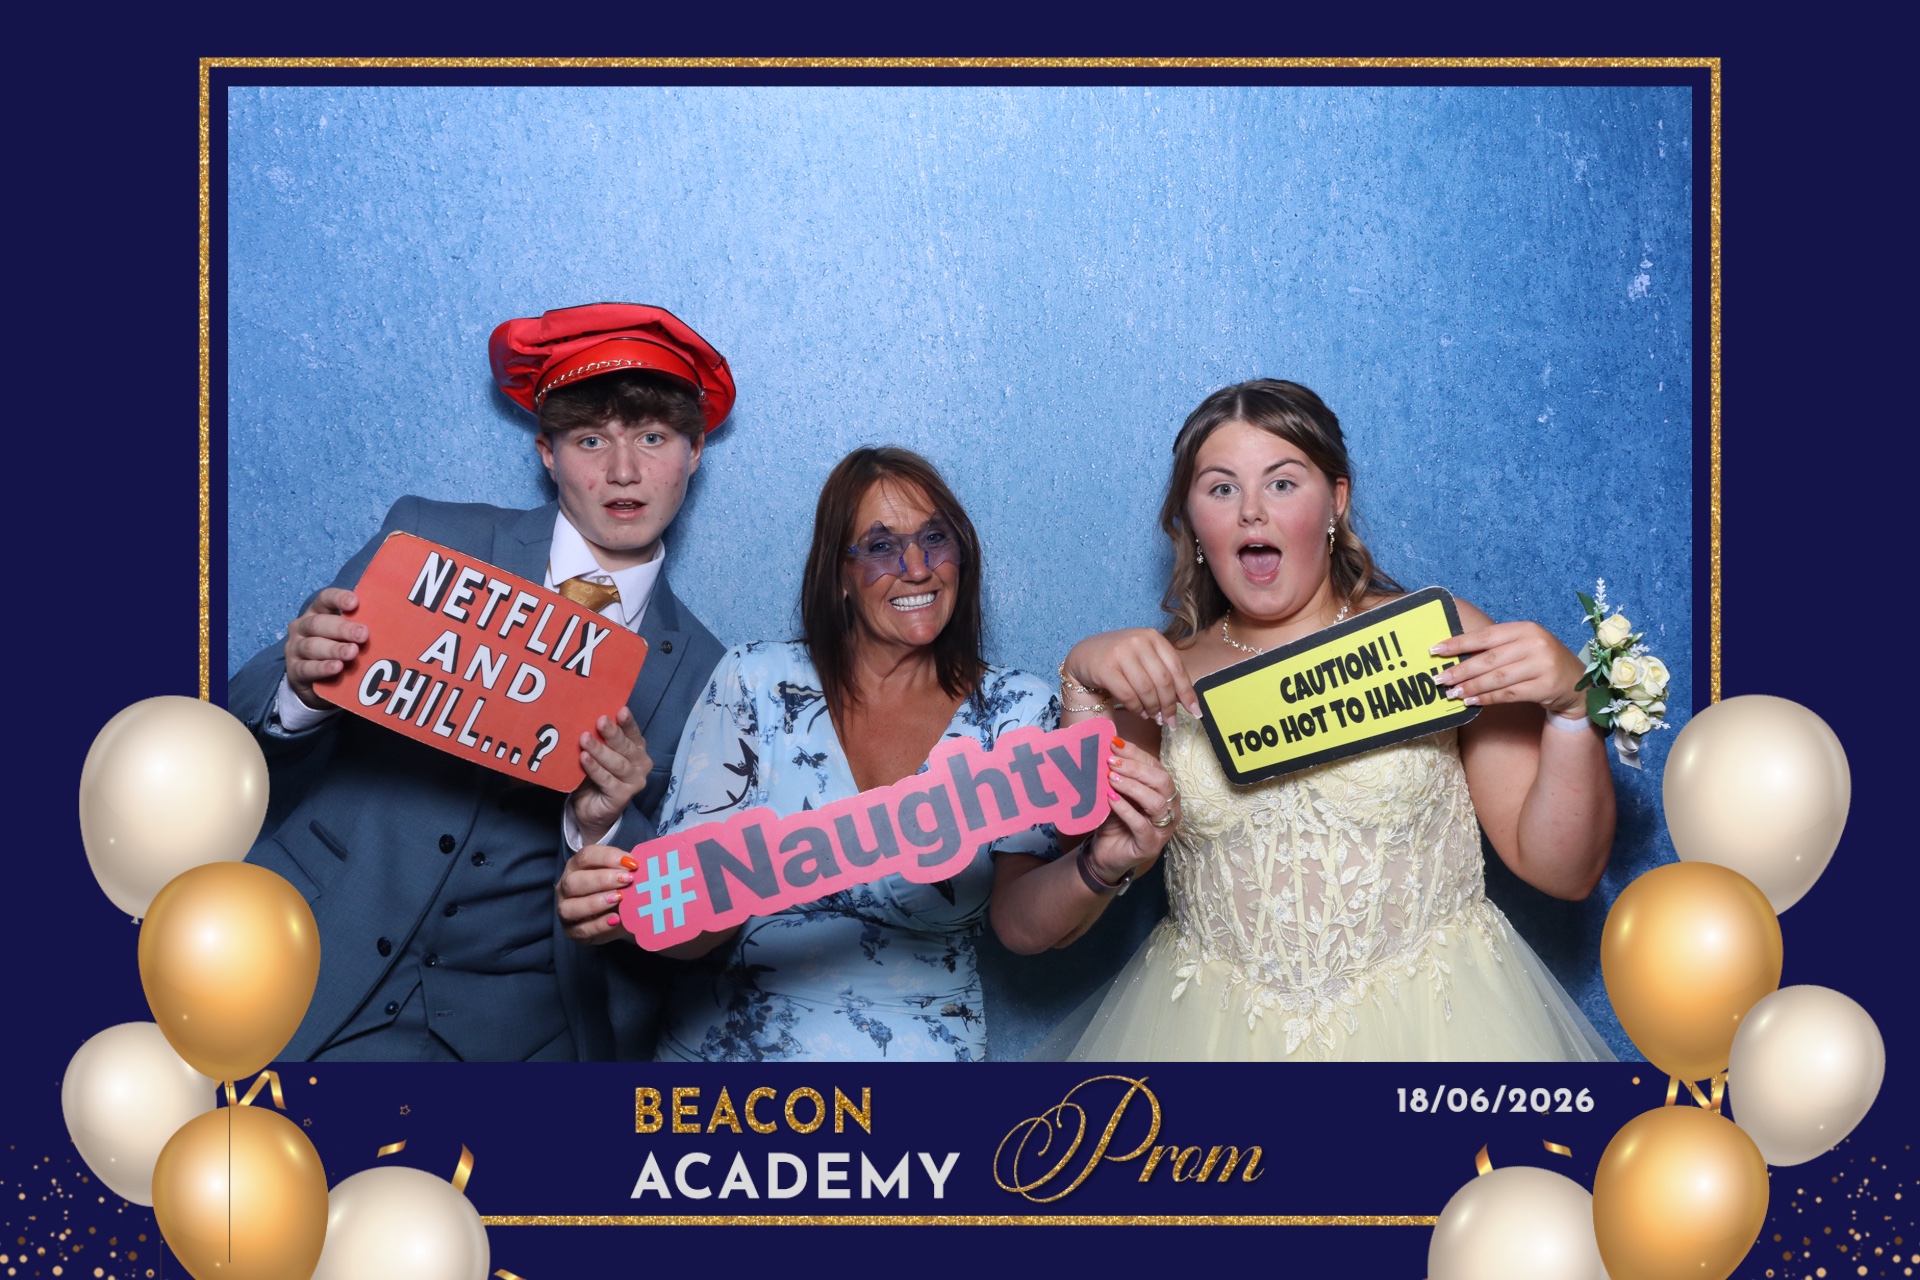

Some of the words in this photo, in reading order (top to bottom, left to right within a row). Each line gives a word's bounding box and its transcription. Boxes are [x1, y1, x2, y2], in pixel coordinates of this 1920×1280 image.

[408, 551, 611, 677] NETFLIX
[419, 630, 547, 703] AND
[1280, 631, 1408, 704] CAUTION!!
[358, 659, 560, 772] CHILL...?
[1228, 725, 1279, 757] TOO
[1280, 706, 1328, 744] HOT
[1329, 696, 1365, 729] TO
[636, 733, 1100, 935] #Naughty
